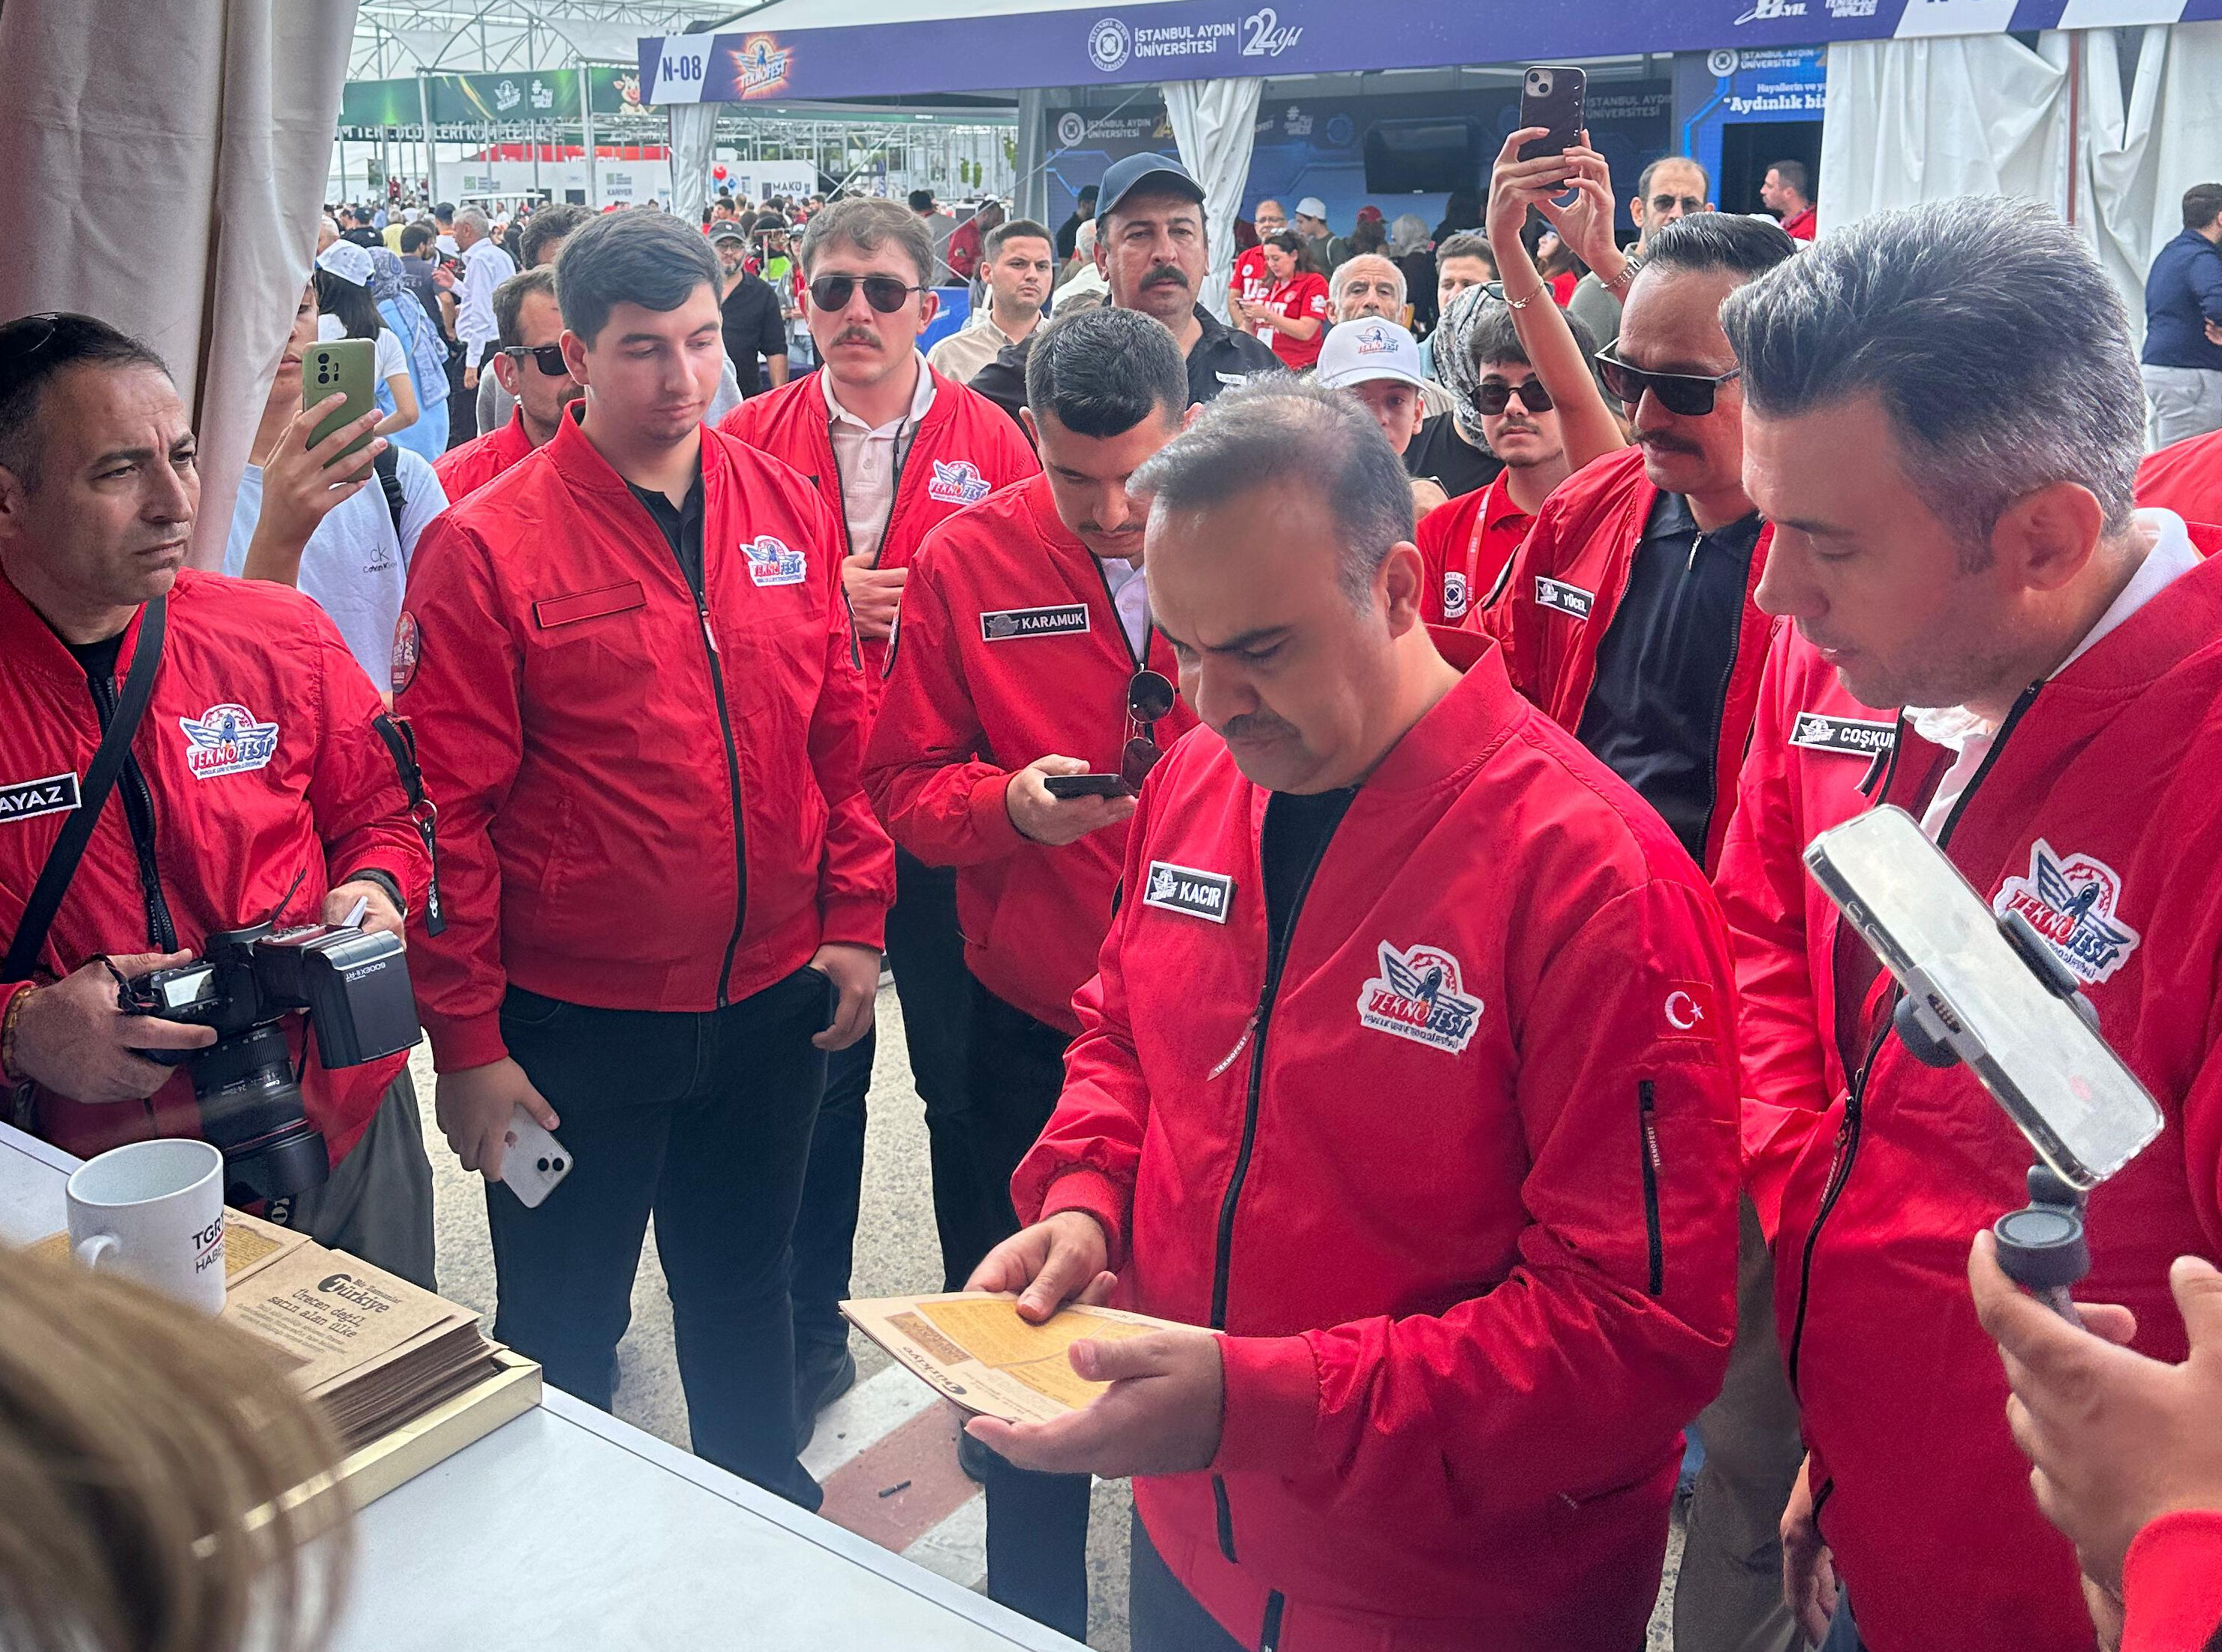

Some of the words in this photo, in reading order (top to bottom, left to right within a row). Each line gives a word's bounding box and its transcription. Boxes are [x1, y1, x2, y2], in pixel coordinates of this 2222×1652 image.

[1134, 27, 1194, 43] İSTANBUL
[1197, 23, 1235, 37] AYDIN
[1135, 40, 1217, 58] ÜNİVERSİTESİ
[1786, 49, 1814, 58] AYDIN
[663, 55, 702, 82] N-08
[741, 60, 788, 88] TEKNOFEST
[1741, 58, 1801, 70] ÜNİVERSİTESİ
[1756, 83, 1804, 94] Hayallerin
[1127, 118, 1152, 127] AYDIN
[773, 181, 802, 192] MAKÜ
[1358, 342, 1399, 354] TEKNOFEST
[930, 481, 987, 501] TEKNOFEST
[1563, 593, 1587, 613] YÜCEL
[1021, 612, 1085, 630] KARAMUK
[189, 737, 276, 770] TEKNOFEST
[1178, 881, 1222, 909] KACIR
[2004, 889, 2120, 970] TEKNOFEST
[1368, 988, 1473, 1040] TEKNOFEST
[1214, 1035, 1247, 1073] TEKNOFEST
[1647, 1127, 1661, 1168] TEKNOFEST
[292, 1287, 331, 1311] Üreten
[328, 1276, 390, 1313] Türkiye
[267, 1295, 301, 1314] satın
[299, 1309, 328, 1326] alan
[329, 1322, 358, 1338] ülke
